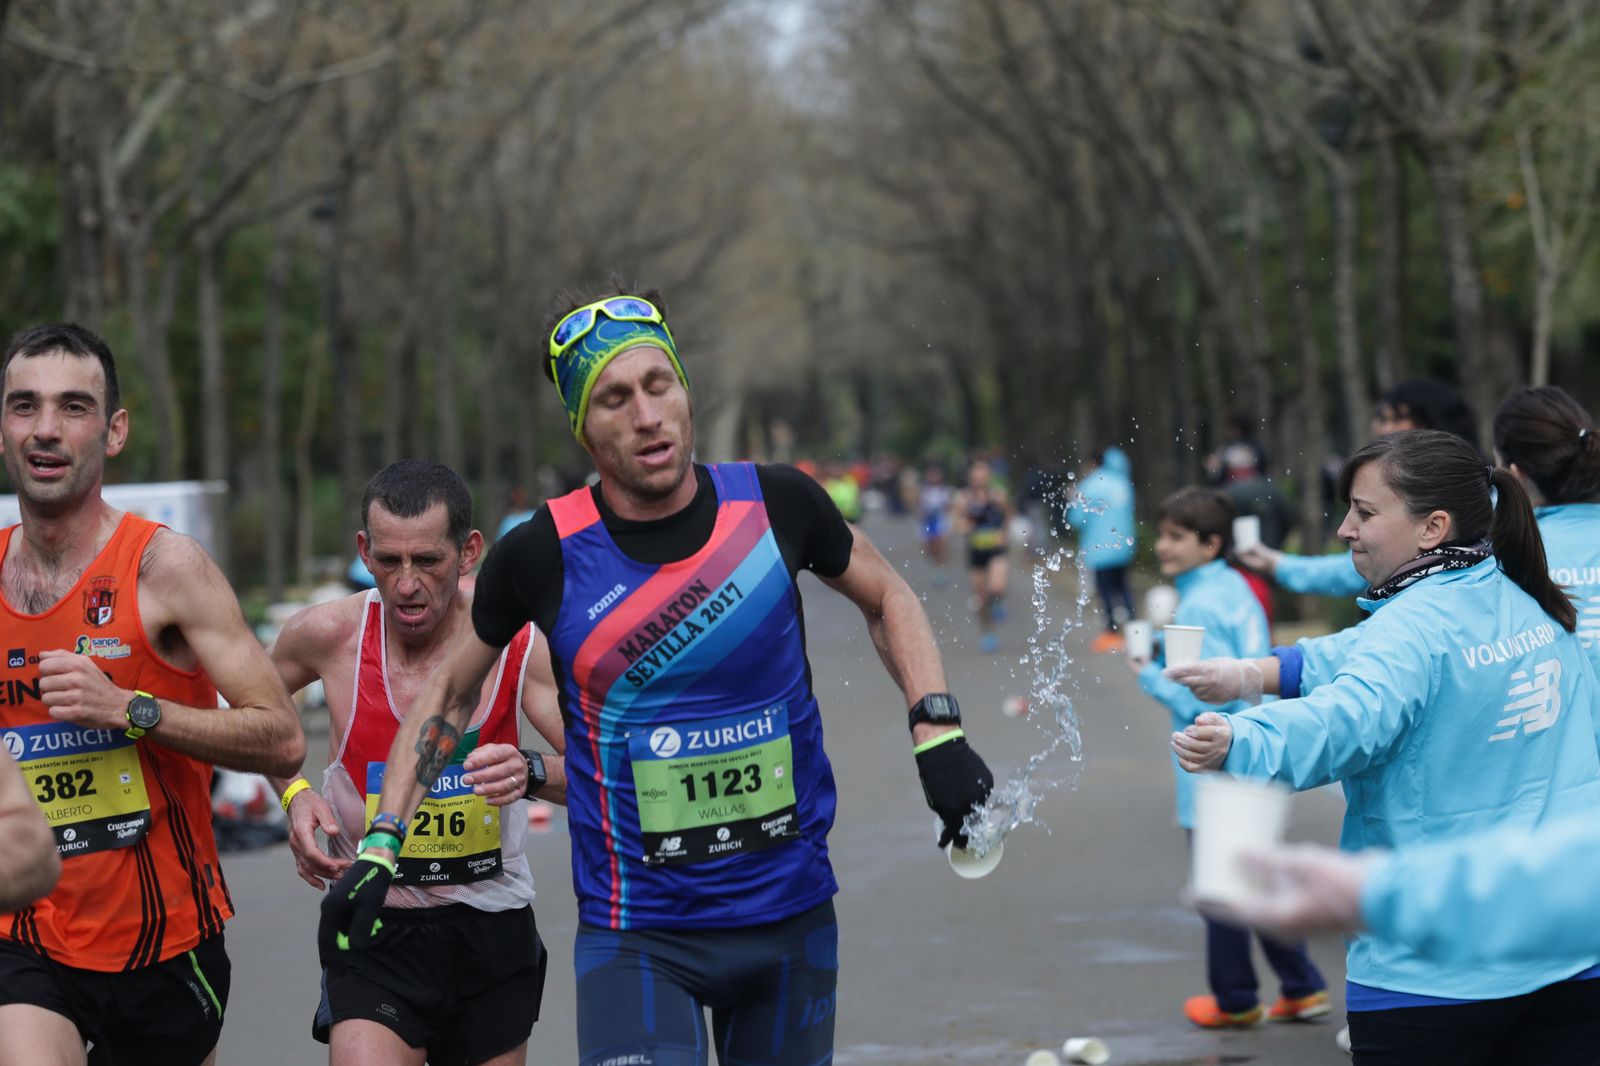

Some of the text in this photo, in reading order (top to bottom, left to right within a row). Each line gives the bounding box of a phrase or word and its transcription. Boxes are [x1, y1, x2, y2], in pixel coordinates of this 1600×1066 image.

[1550, 567, 1600, 586] OLU
[617, 578, 712, 665] MARATON
[624, 581, 744, 688] SEVILLA 2017
[29, 729, 113, 753] ZURICH
[687, 718, 773, 750] ZURICH
[35, 769, 97, 803] 382
[680, 764, 762, 802] 1123
[43, 804, 92, 821] ALBERTO
[698, 803, 746, 820] WALLAS
[107, 818, 145, 832] Cruzcampo
[413, 811, 466, 837] 216
[56, 840, 89, 853] ZURICH
[408, 843, 464, 853] CORDEIRO
[708, 840, 743, 853] ZURICH
[420, 873, 450, 881] ZURICH
